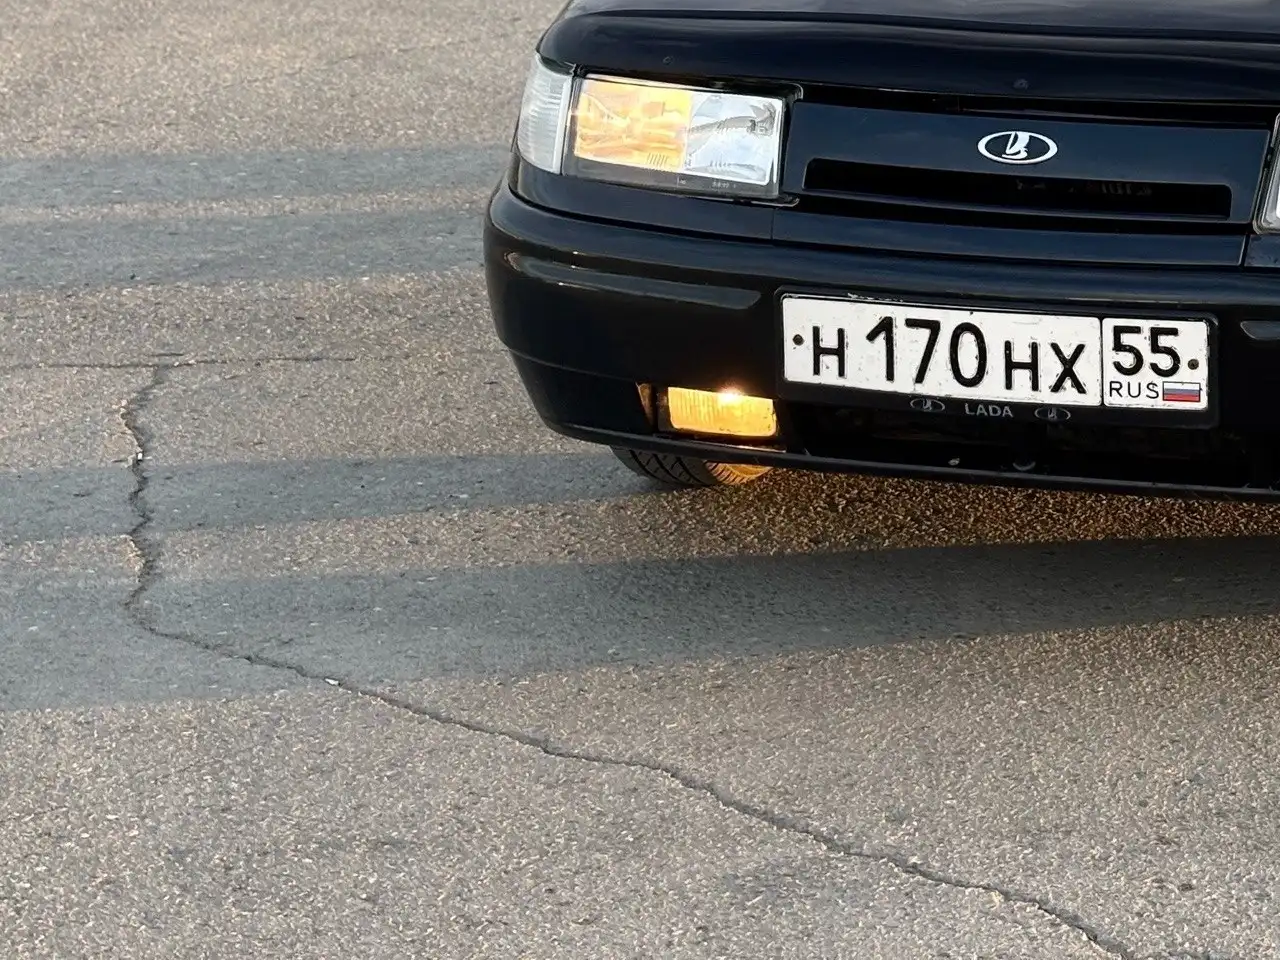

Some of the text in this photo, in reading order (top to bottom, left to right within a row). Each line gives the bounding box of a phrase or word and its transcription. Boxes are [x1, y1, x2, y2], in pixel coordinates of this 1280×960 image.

[1111, 325, 1182, 378] 55
[1108, 381, 1160, 400] RUS
[963, 401, 1014, 420] LADA
